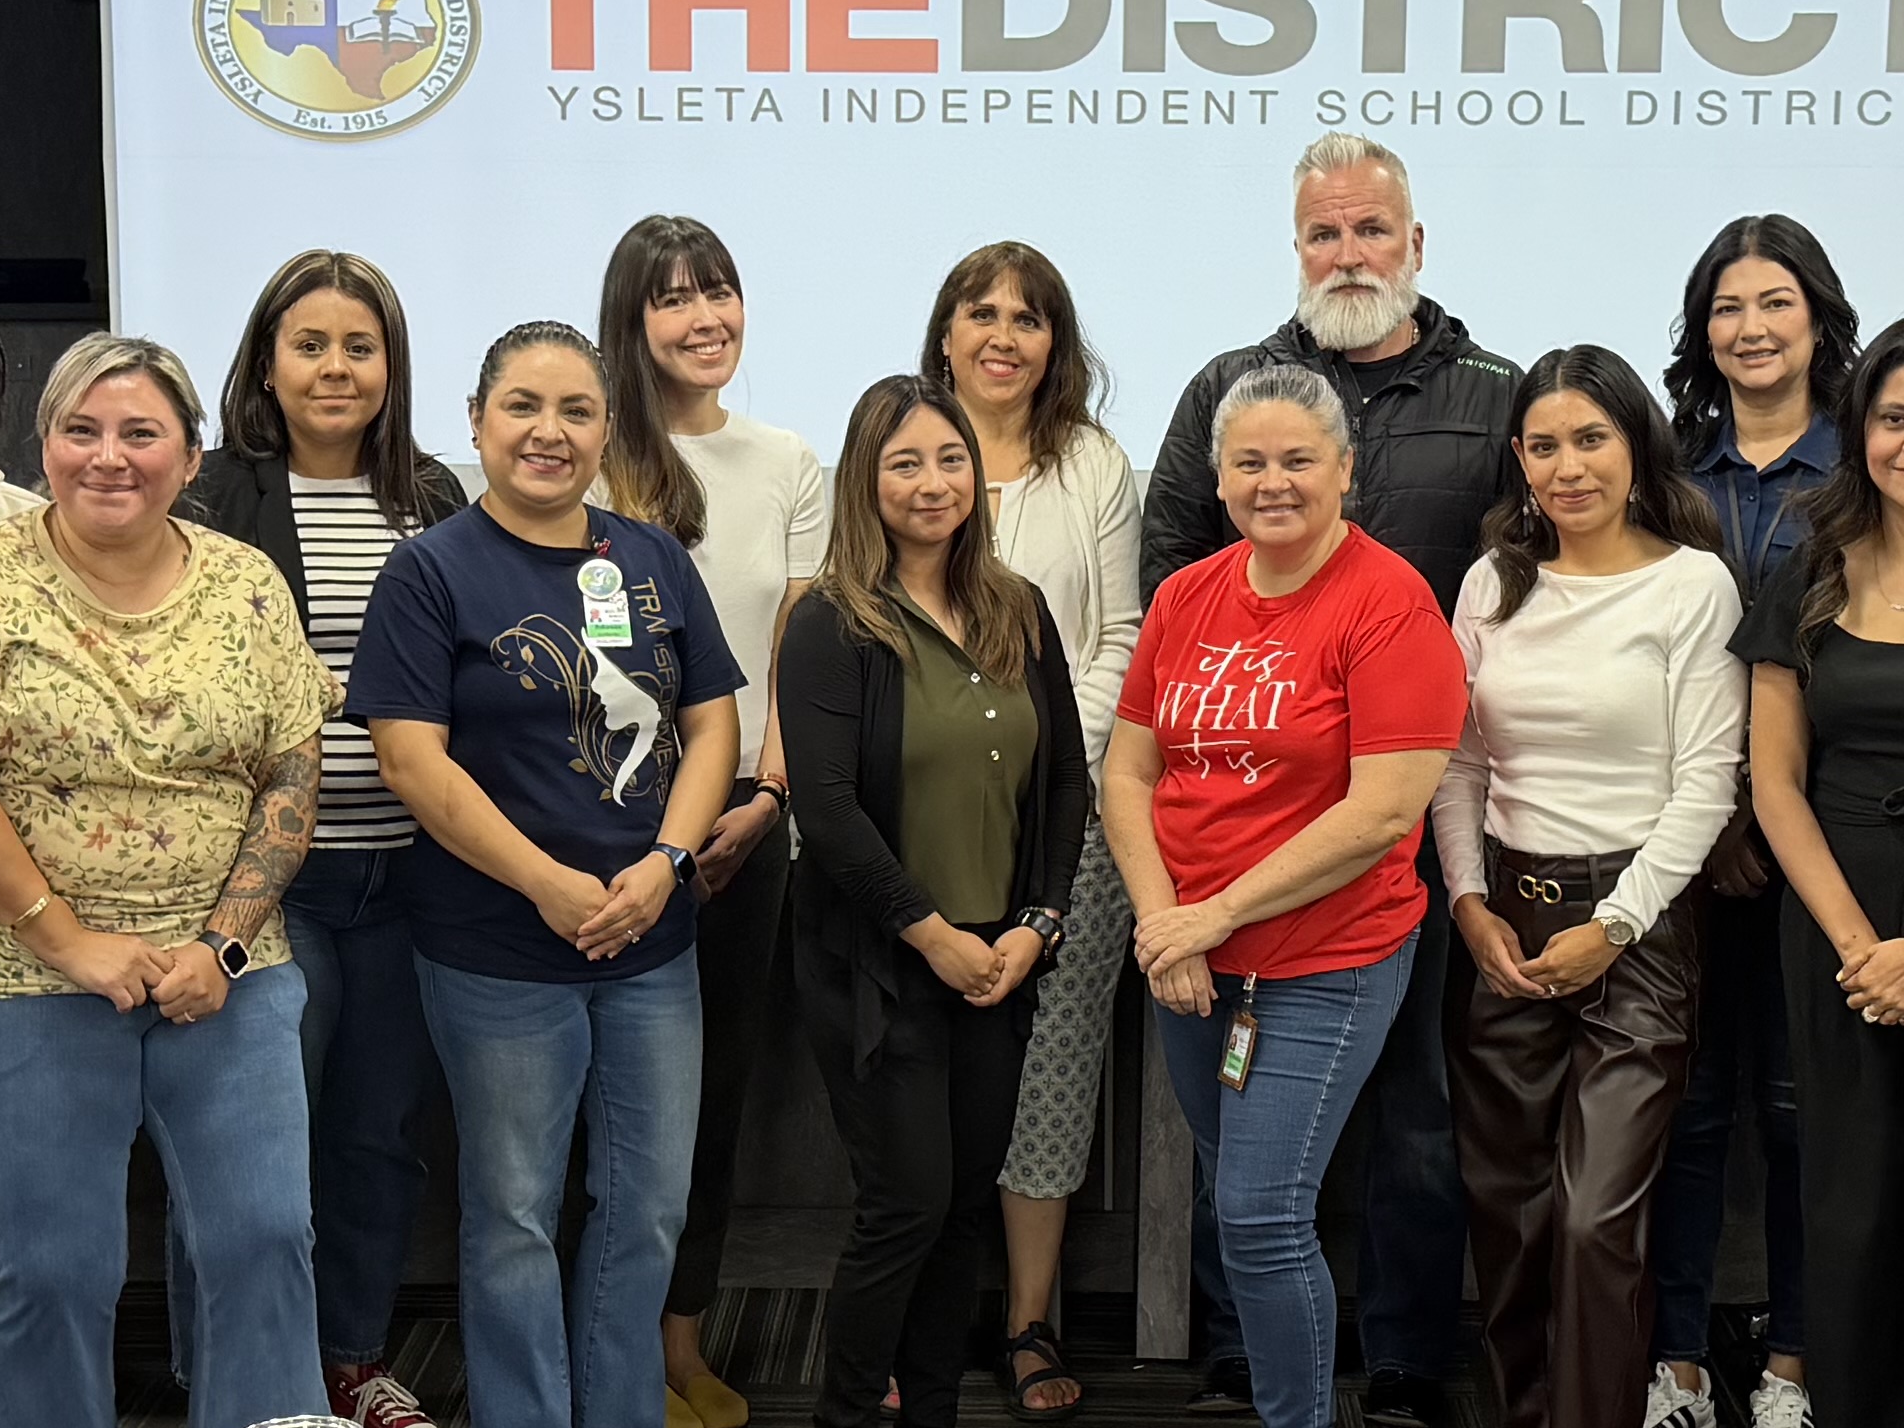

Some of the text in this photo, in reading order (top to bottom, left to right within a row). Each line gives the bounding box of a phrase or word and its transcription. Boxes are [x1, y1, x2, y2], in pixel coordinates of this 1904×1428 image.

[207, 24, 266, 106] YSLETA
[293, 108, 389, 132] Est. 1915
[546, 85, 784, 124] YSLETA
[822, 87, 1280, 126] INDEPENDENT
[1315, 88, 1586, 128] SCHOOL
[1158, 680, 1296, 731] WHAT
